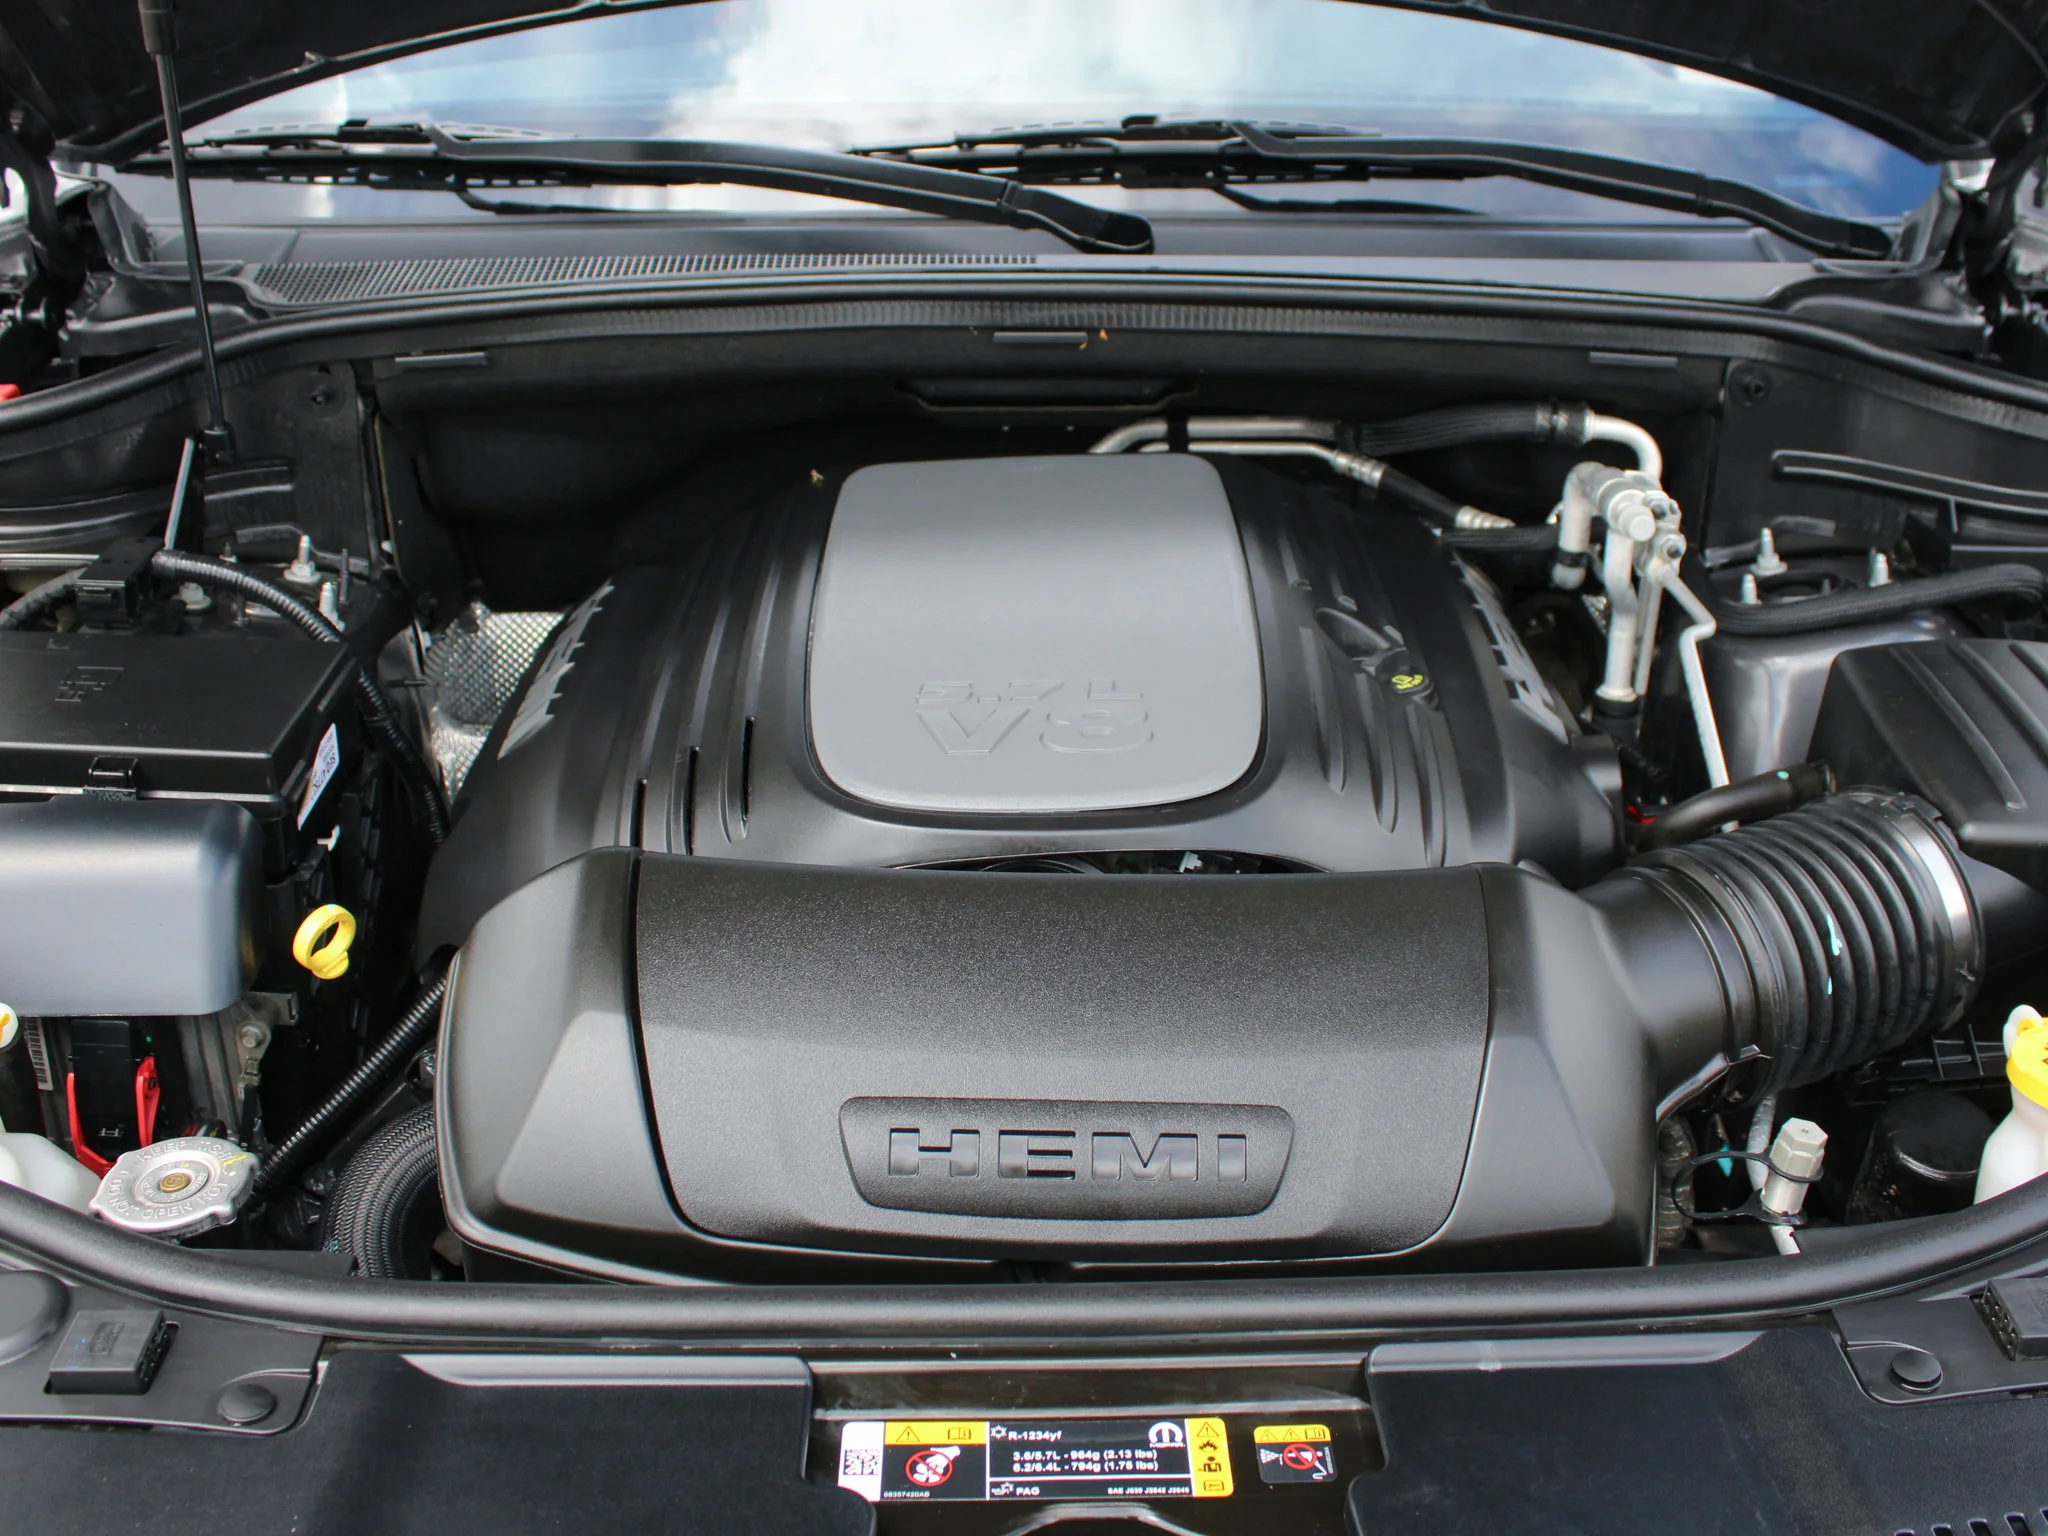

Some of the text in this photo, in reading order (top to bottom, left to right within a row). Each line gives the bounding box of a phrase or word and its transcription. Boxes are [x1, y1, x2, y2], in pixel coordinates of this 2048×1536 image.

[915, 705, 1155, 756] V8
[137, 1140, 187, 1162] KEEP
[889, 1127, 1246, 1183] HEMI
[141, 1201, 194, 1219] OPEN
[1008, 1430, 1062, 1443] R-1234yf
[1013, 1451, 1062, 1462] 3.6/5.7L
[1103, 1449, 1133, 1461] (2.13
[1135, 1449, 1158, 1461] lbs)
[1136, 1460, 1159, 1472] lbs)
[1016, 1487, 1040, 1496] PAG
